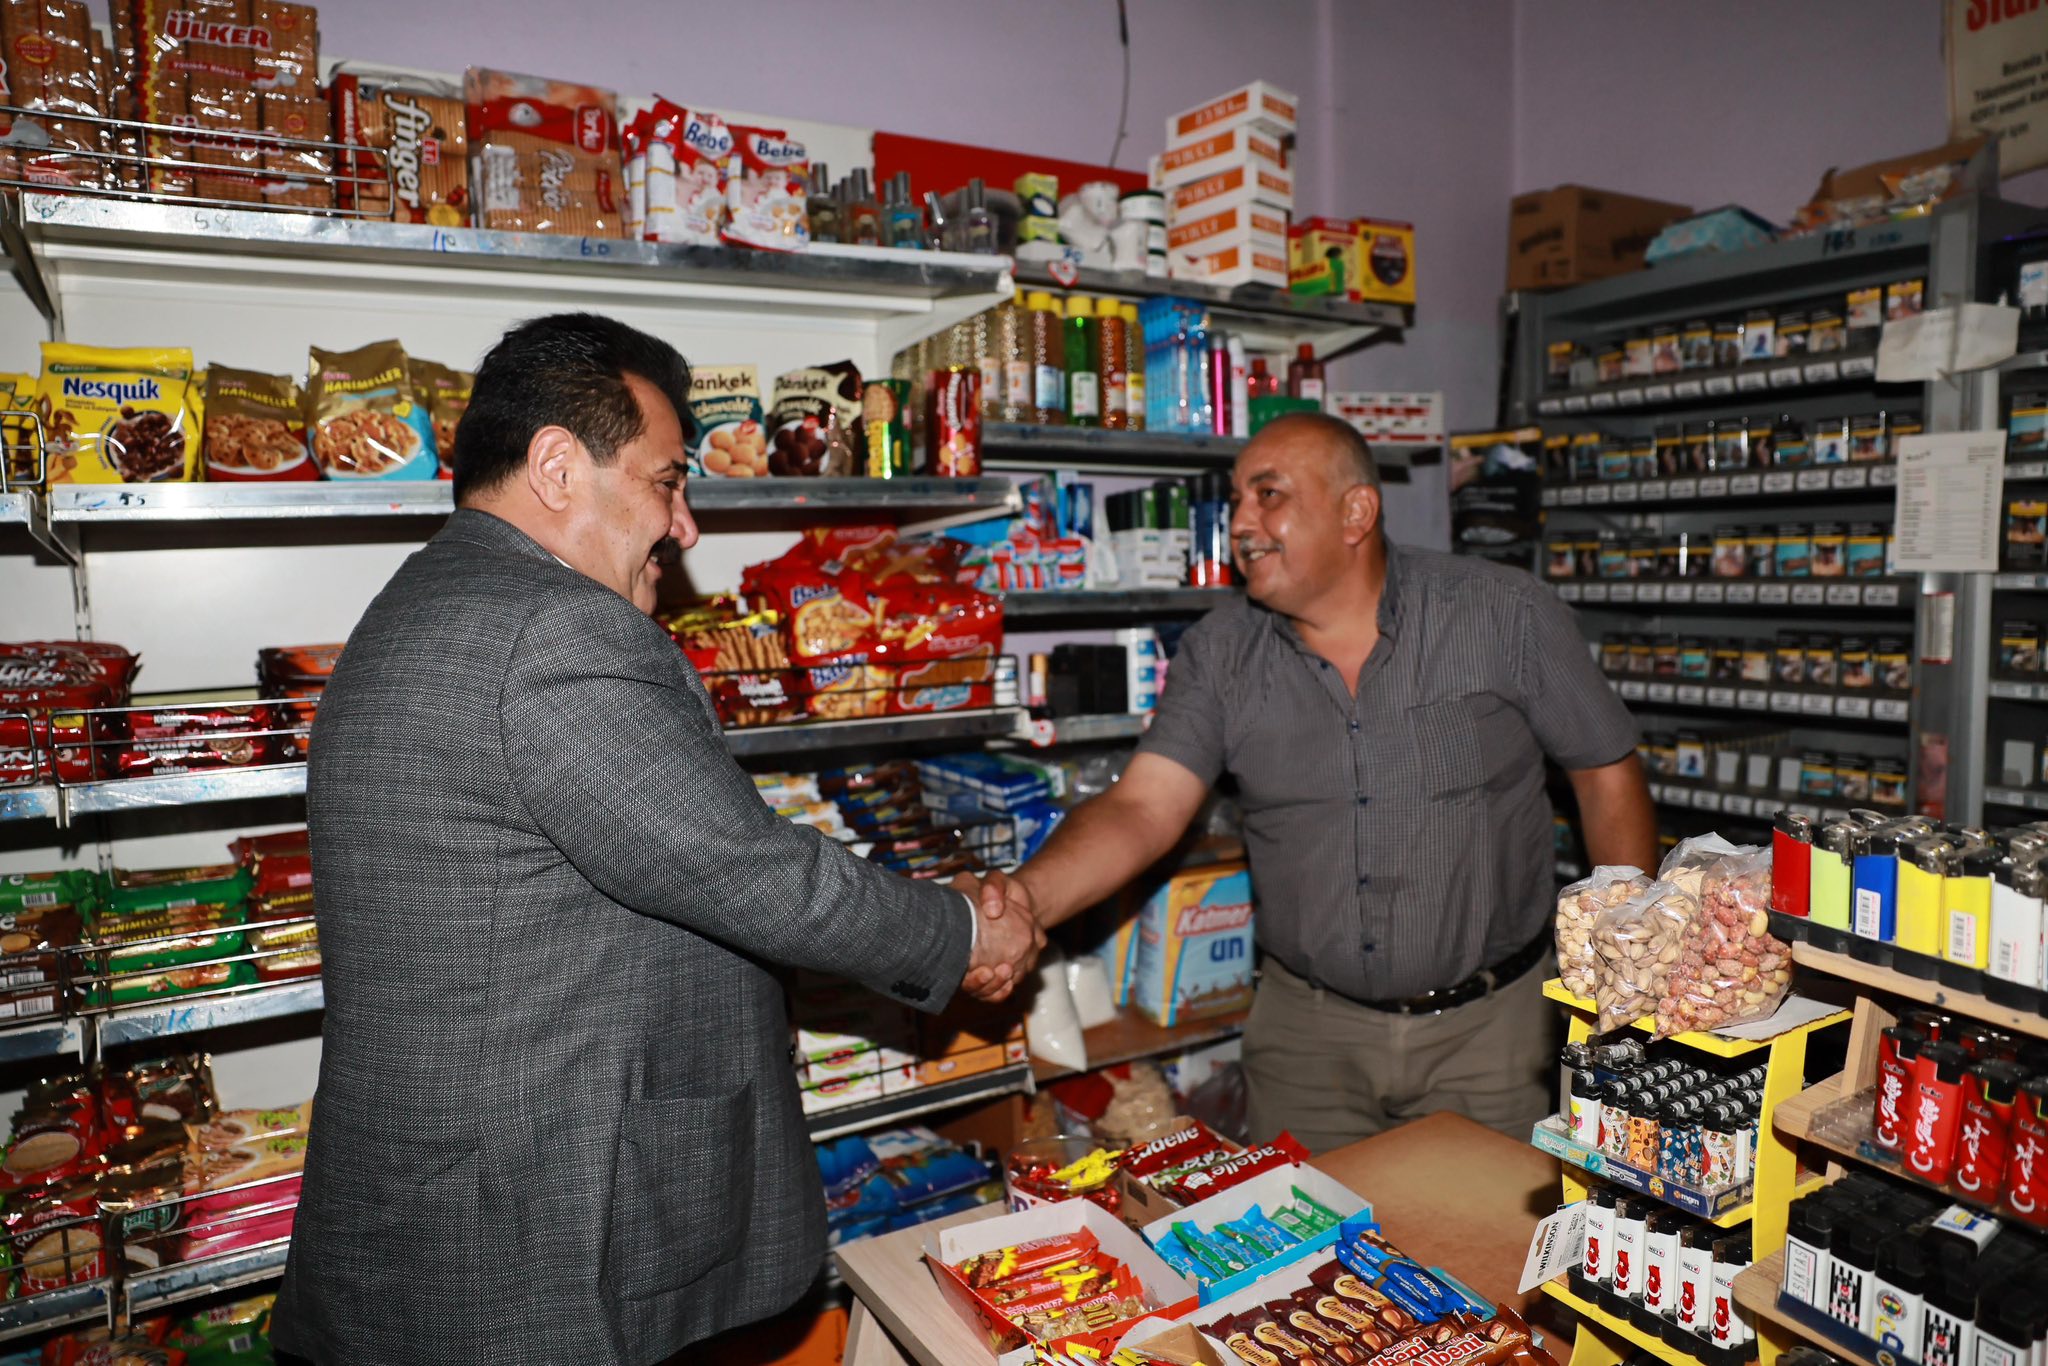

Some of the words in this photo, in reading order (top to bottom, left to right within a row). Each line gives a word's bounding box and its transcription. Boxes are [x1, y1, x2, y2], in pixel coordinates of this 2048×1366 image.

[166, 11, 272, 50] ÜLKER
[384, 93, 431, 208] finger
[757, 139, 806, 157] Bebe
[63, 377, 160, 405] Nesquik
[323, 367, 403, 393] HANIMELLER
[693, 371, 753, 392] ankek
[218, 388, 297, 409] HANIMELLER
[1210, 935, 1244, 962] un
[1680, 1192, 1700, 1205] mgm
[1539, 1220, 1560, 1272] WILKINSON
[1410, 1332, 1488, 1366] Albeni
